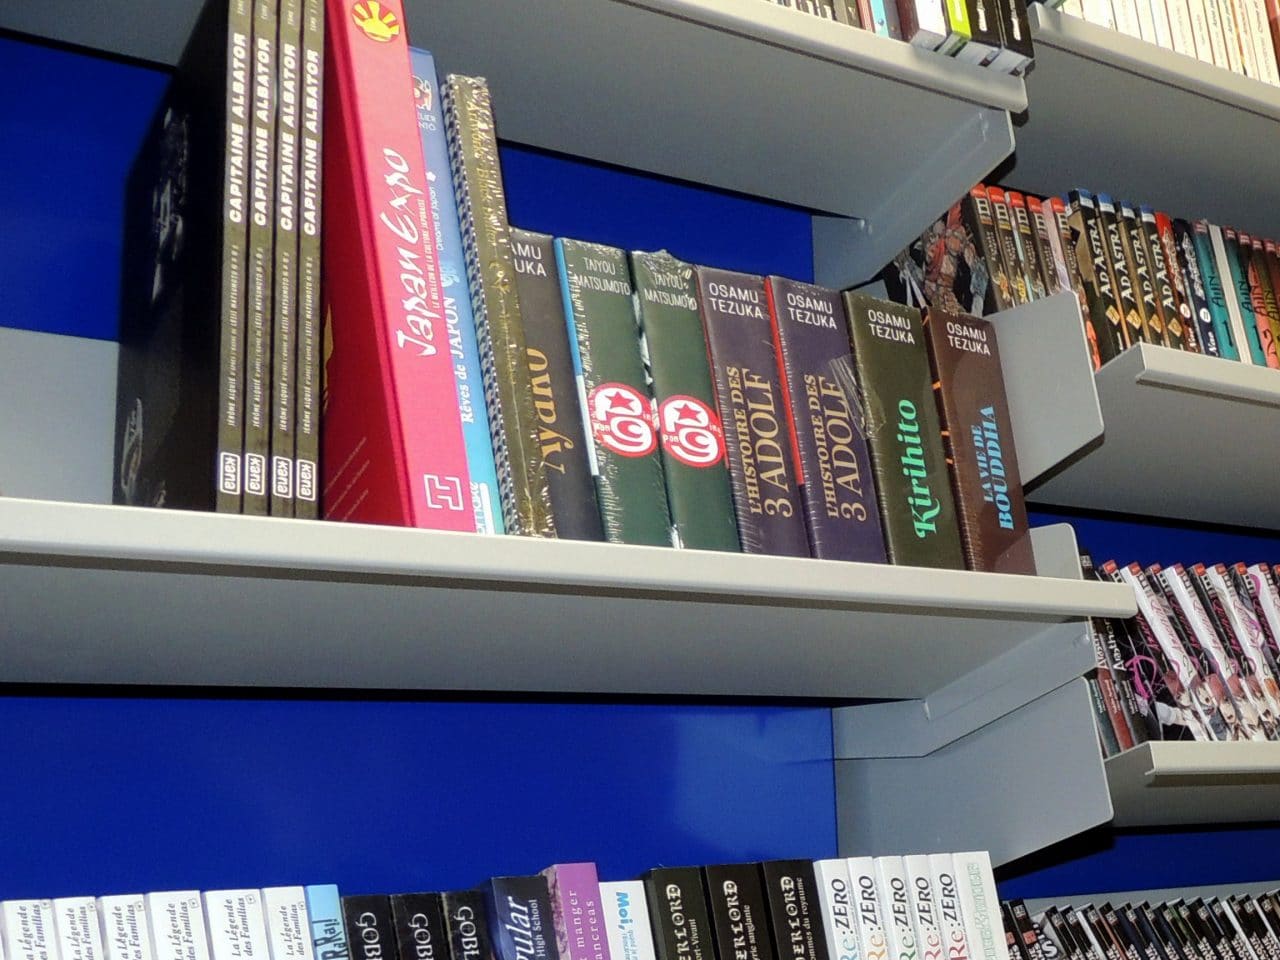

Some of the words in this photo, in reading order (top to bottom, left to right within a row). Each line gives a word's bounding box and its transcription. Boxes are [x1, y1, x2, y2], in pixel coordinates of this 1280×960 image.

[232, 33, 247, 119] ALBATOR
[256, 38, 270, 123] ALBATOR
[282, 43, 296, 128] ALBATOR
[305, 49, 319, 134] ALBATOR
[229, 123, 244, 223] CAPITAINE
[254, 127, 269, 226] CAPITAINE
[280, 132, 295, 231] CAPITAINE
[304, 137, 319, 236] CAPITAINE
[380, 148, 424, 245] Expo
[1087, 218, 1104, 266] ASTRA
[574, 273, 631, 296] MATSUMOTO
[584, 257, 616, 275] TAIYOU
[397, 245, 442, 357] Japan
[709, 283, 759, 303] OSAMU
[787, 292, 833, 315] OSAMU
[1100, 271, 1114, 299] AD
[710, 298, 764, 319] TEZUKA
[788, 307, 837, 330] TEZUKA
[868, 309, 911, 331] OSAMU
[444, 297, 464, 358] JAPON
[870, 323, 915, 345] TEZUKA
[947, 322, 987, 342] OSAMU
[948, 335, 990, 356] TEZUKA
[726, 366, 743, 404] DES
[804, 374, 821, 411] DES
[742, 367, 789, 493] ADOLF
[818, 376, 863, 497] ADOLF
[971, 424, 986, 448] DE
[223, 456, 237, 492] kana
[734, 408, 762, 515] L'HISTOIRE
[811, 415, 839, 519] L'HISTOIRE
[897, 399, 941, 538] Kirihito
[976, 450, 990, 479] VIE
[980, 406, 1014, 531] BOUDDHA
[764, 498, 793, 518] 3
[982, 482, 995, 503] LA
[841, 501, 867, 522] 3
[528, 899, 542, 935] School
[569, 890, 585, 948] manger
[535, 936, 547, 957] High
